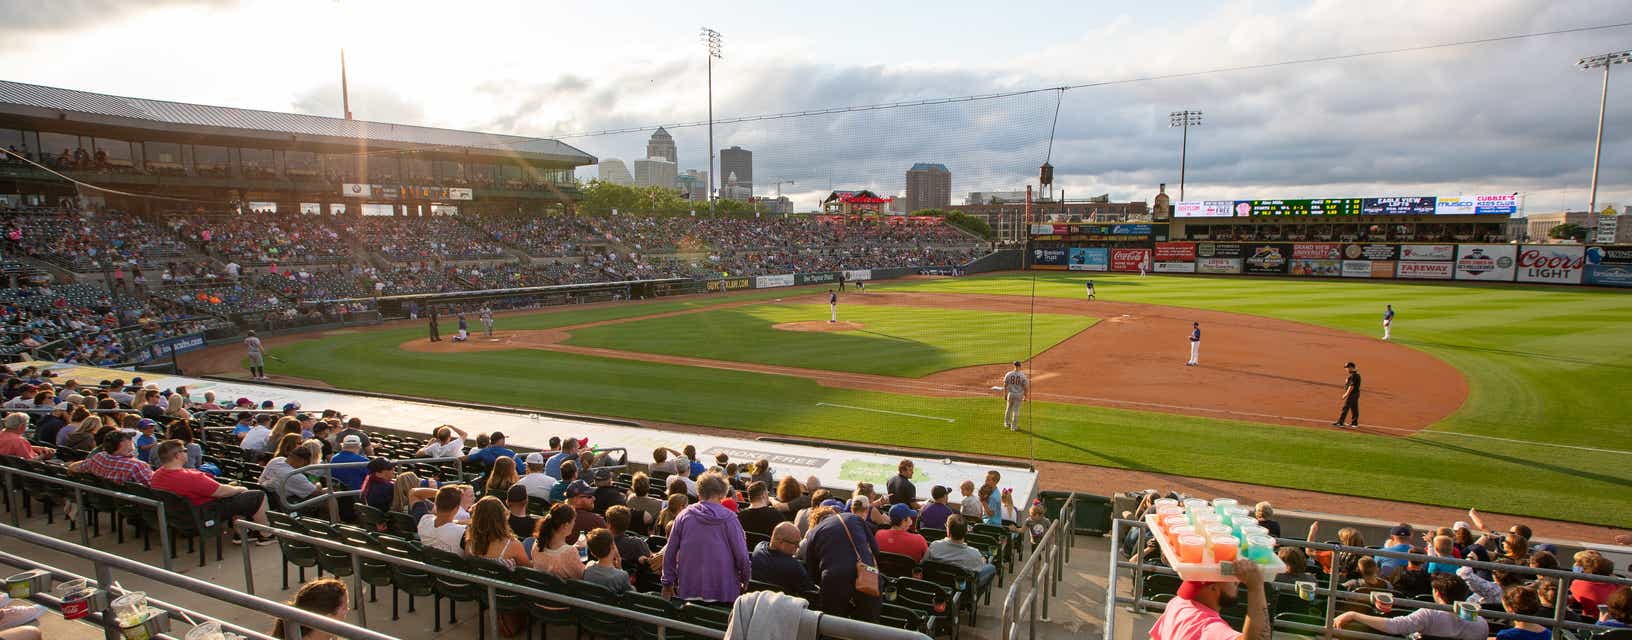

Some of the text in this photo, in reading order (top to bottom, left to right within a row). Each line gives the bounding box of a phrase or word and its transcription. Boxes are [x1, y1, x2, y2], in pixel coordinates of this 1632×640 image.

[1114, 250, 1142, 260] Coca-Cola
[1520, 249, 1584, 269] Coors
[1401, 264, 1449, 272] FAREWAY
[1528, 268, 1571, 279] LIGHT
[1010, 375, 1021, 385] 80
[771, 454, 818, 467] FREE
